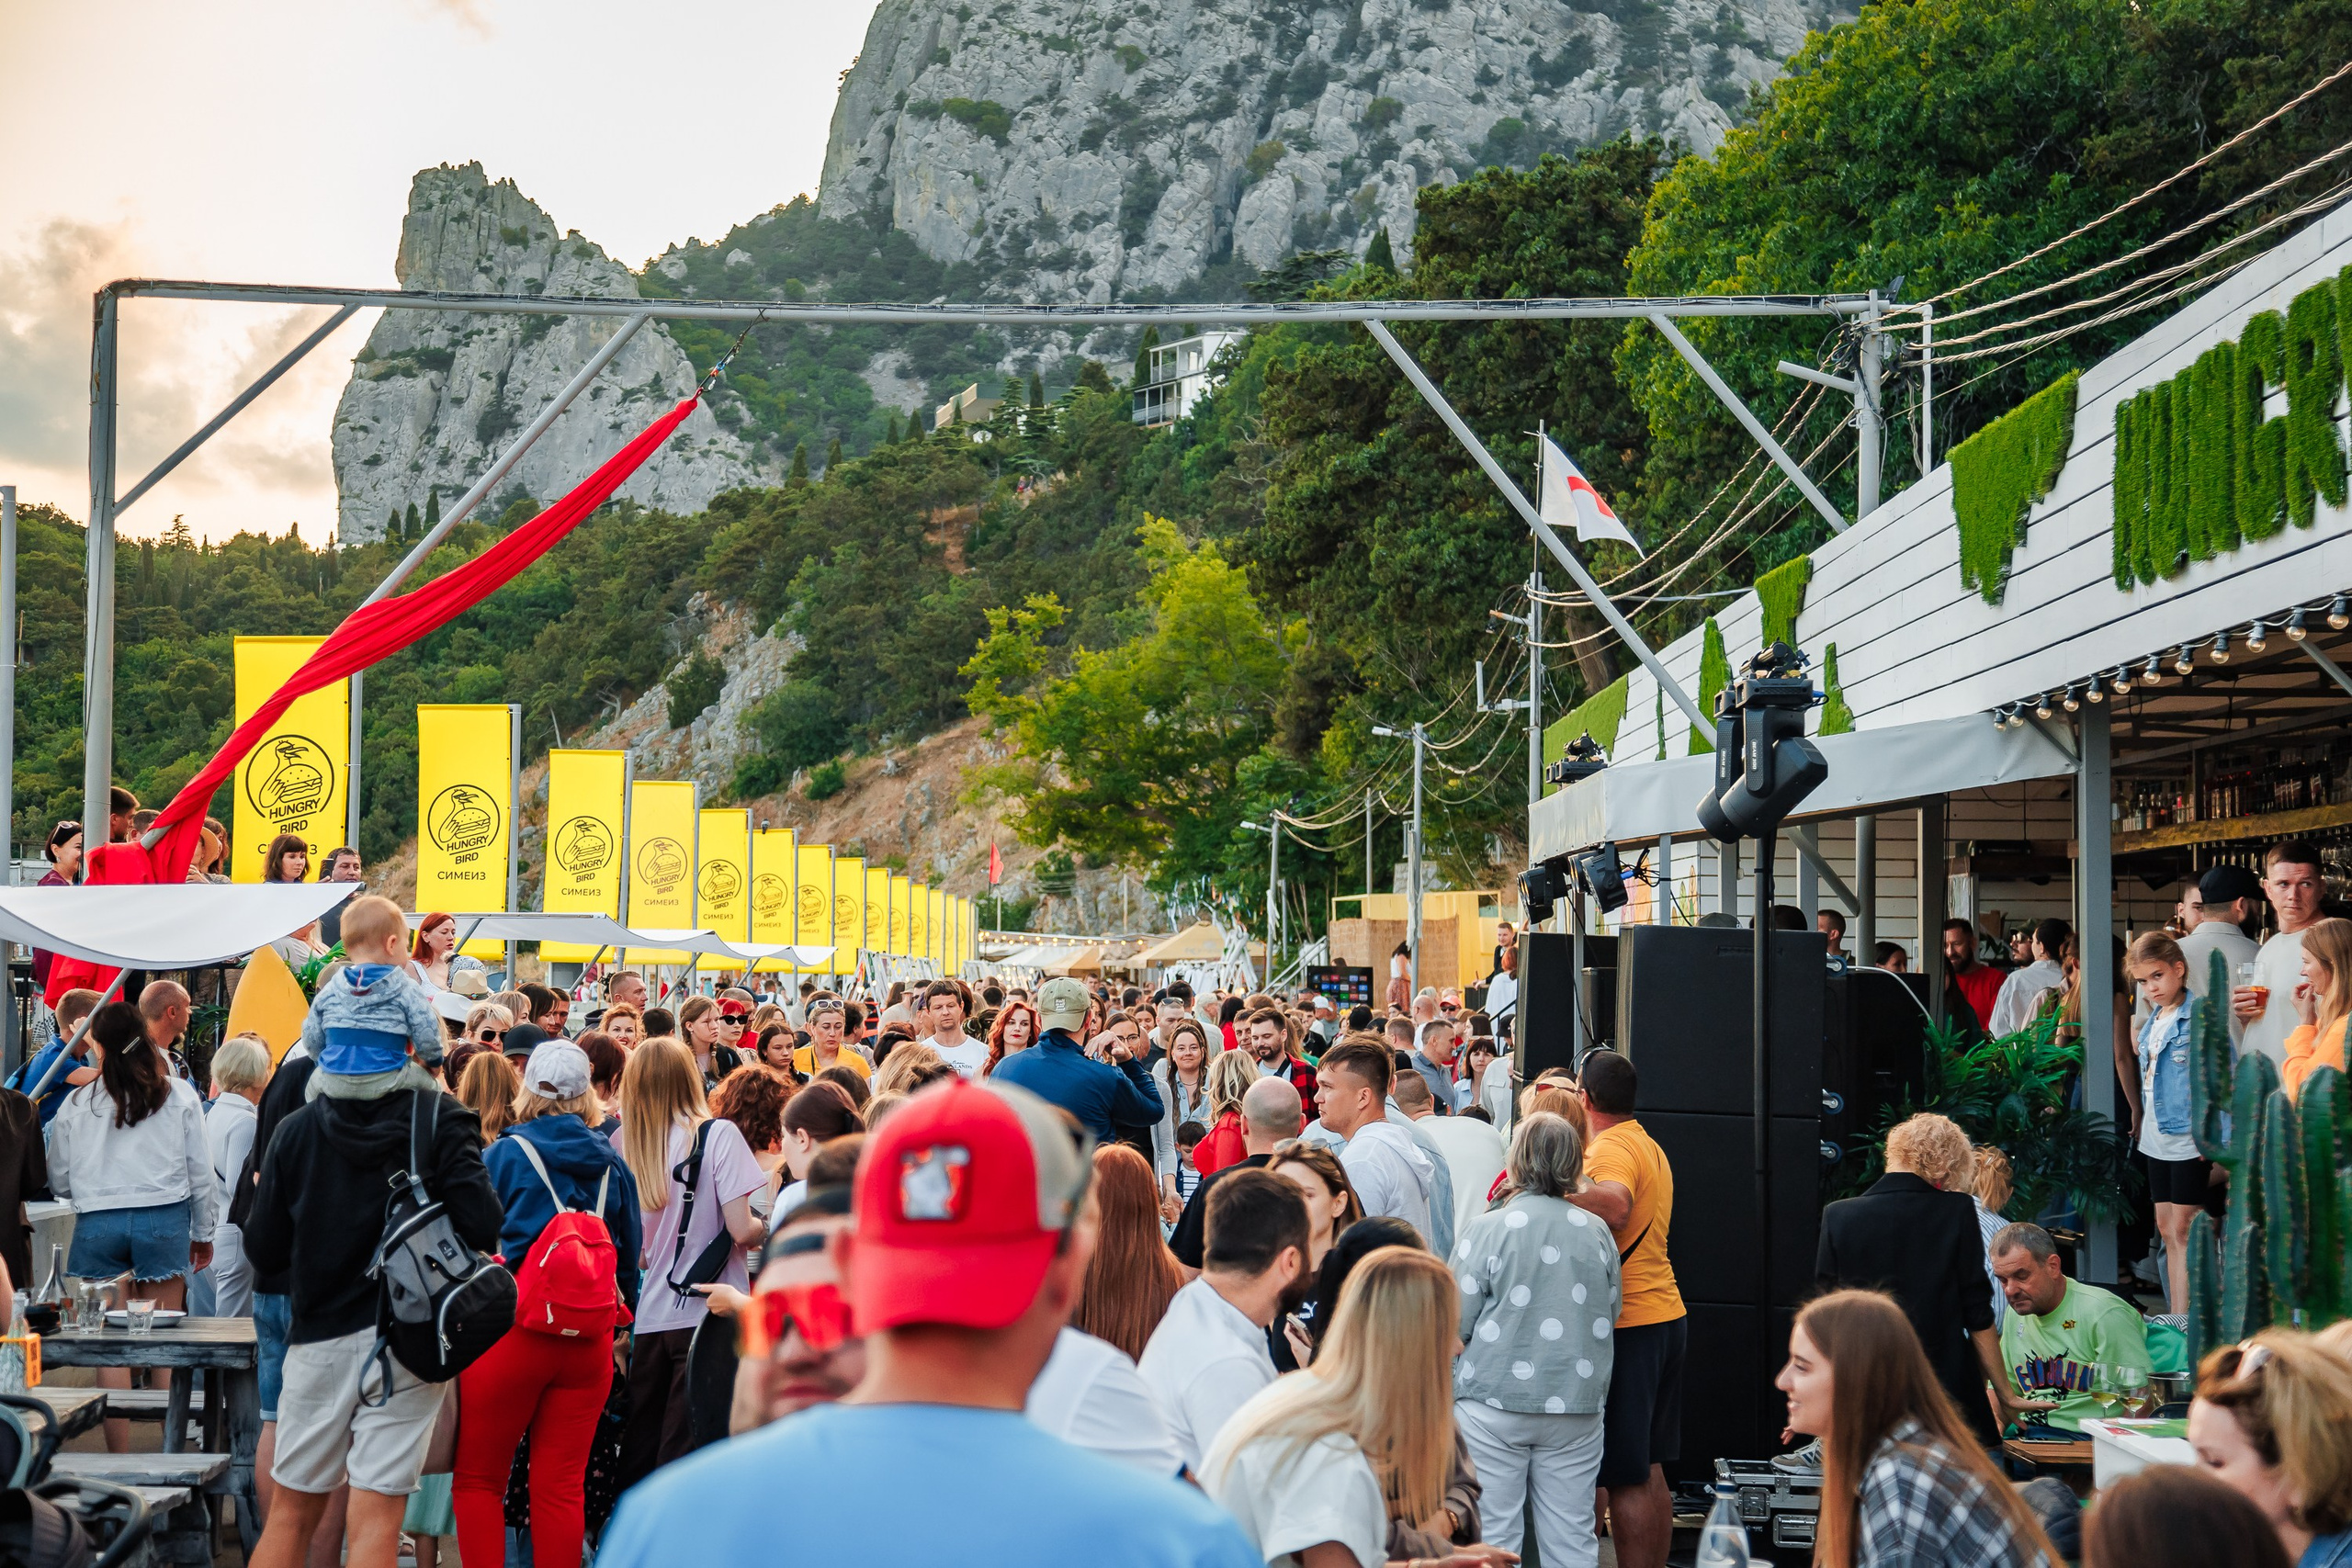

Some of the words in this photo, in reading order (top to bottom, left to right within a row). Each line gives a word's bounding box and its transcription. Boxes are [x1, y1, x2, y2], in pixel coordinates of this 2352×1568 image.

[2112, 263, 2352, 593] HUNGR
[269, 798, 321, 819] HUNGRY
[279, 819, 309, 835] BIRD
[447, 835, 490, 852] HUNGRY
[455, 852, 480, 864] BIRD
[569, 859, 605, 873] HUNGRY
[437, 871, 486, 881] СИМЕИЗ
[575, 873, 595, 883] BIRD
[650, 874, 681, 886] HUNGRY
[561, 887, 601, 897] СИМЕИЗ
[657, 886, 674, 896] BIRD
[708, 891, 735, 902] HUNGRY
[714, 901, 729, 910] BIRD
